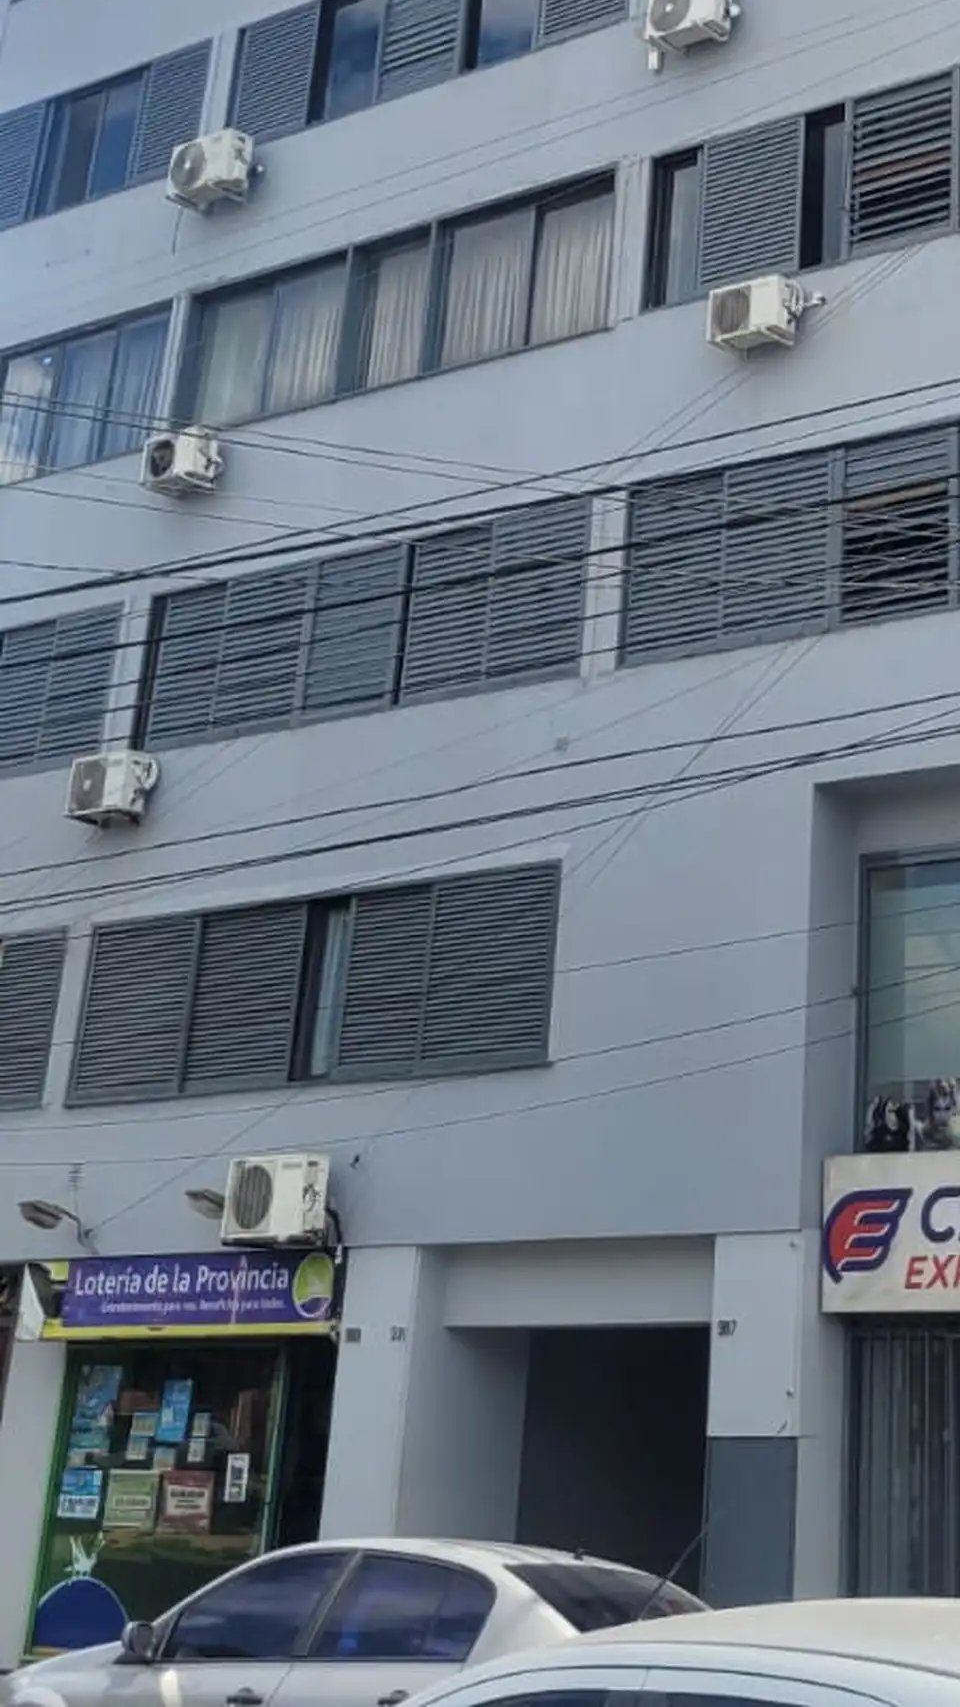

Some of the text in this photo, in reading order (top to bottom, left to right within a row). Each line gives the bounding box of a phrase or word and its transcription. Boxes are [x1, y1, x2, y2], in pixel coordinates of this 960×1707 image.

[74, 1261, 289, 1295] Lotería de la Provincia
